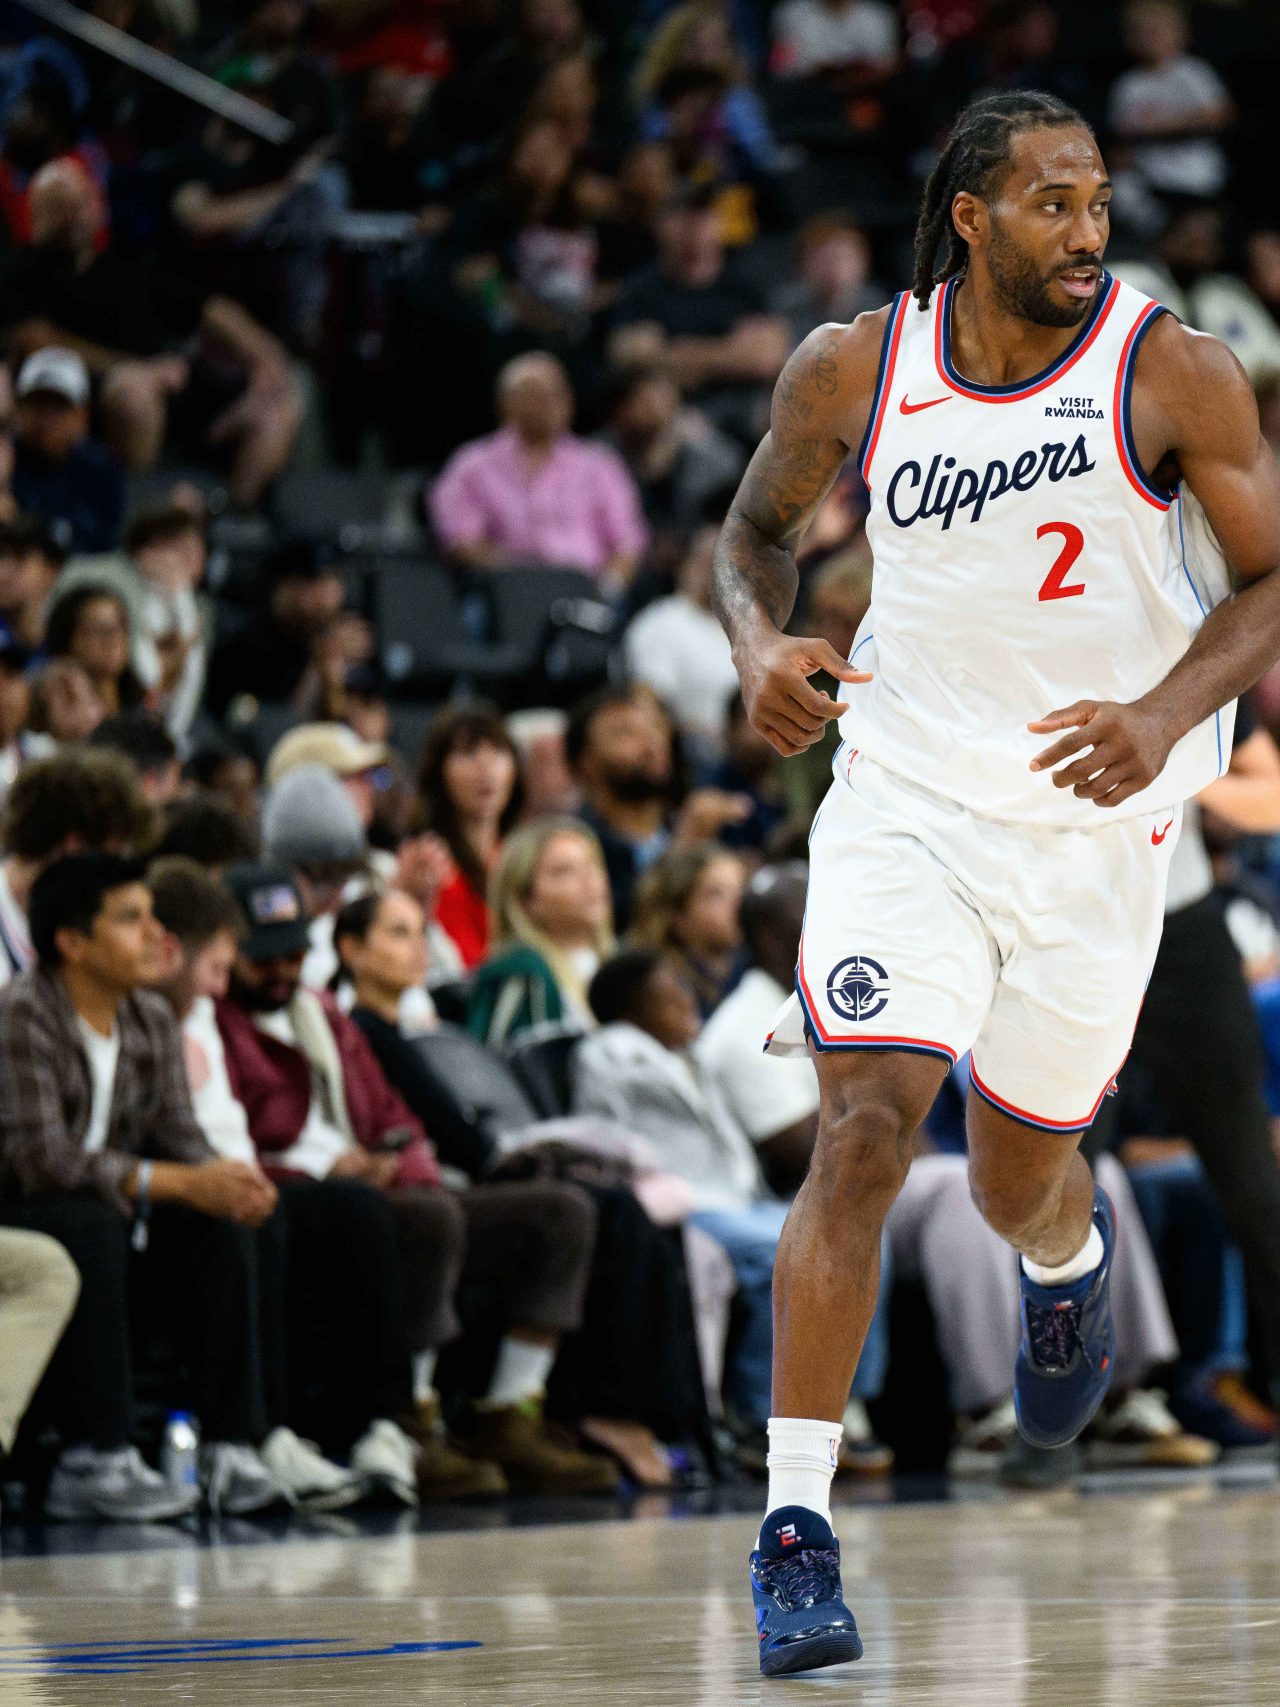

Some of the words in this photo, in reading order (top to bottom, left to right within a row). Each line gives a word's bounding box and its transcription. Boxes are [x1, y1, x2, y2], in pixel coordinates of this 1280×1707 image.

[1044, 407, 1105, 419] RWANDA
[1059, 397, 1094, 408] VISIT
[886, 433, 1097, 532] Clippers
[1036, 521, 1085, 602] 2
